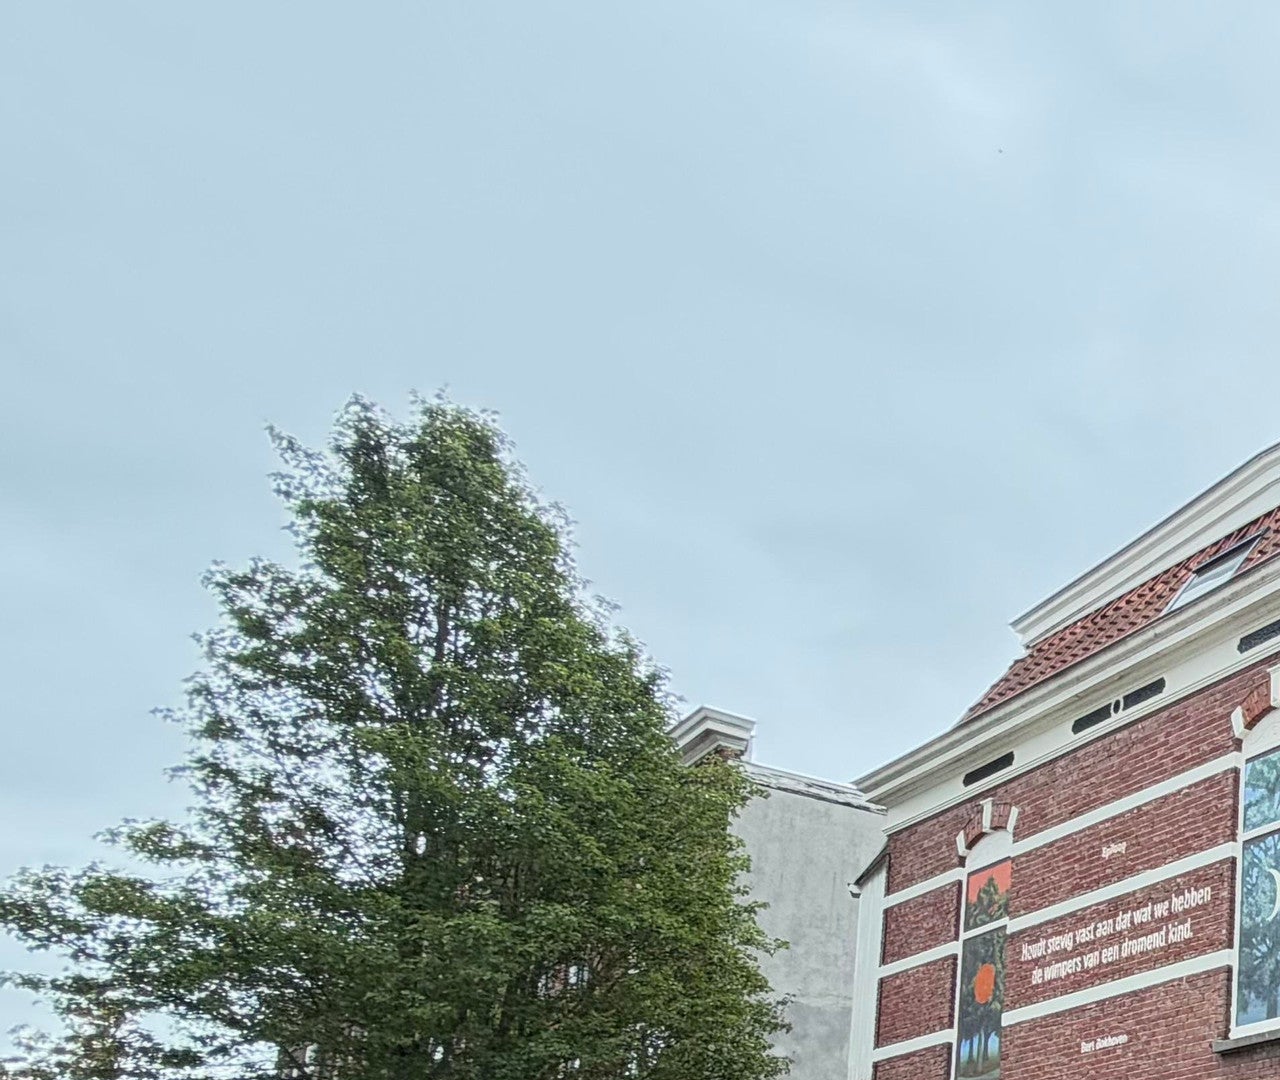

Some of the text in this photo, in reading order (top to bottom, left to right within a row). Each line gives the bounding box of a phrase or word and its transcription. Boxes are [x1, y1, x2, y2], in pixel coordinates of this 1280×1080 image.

[1031, 917, 1193, 984] de wimpers van een dromend kind.
[1047, 929, 1073, 951] stevig
[1075, 922, 1095, 943] vast
[1096, 918, 1114, 937] aan
[1115, 910, 1132, 931] dat
[1133, 902, 1152, 925] wat
[1154, 900, 1169, 919] we
[1171, 886, 1211, 913] hebben
